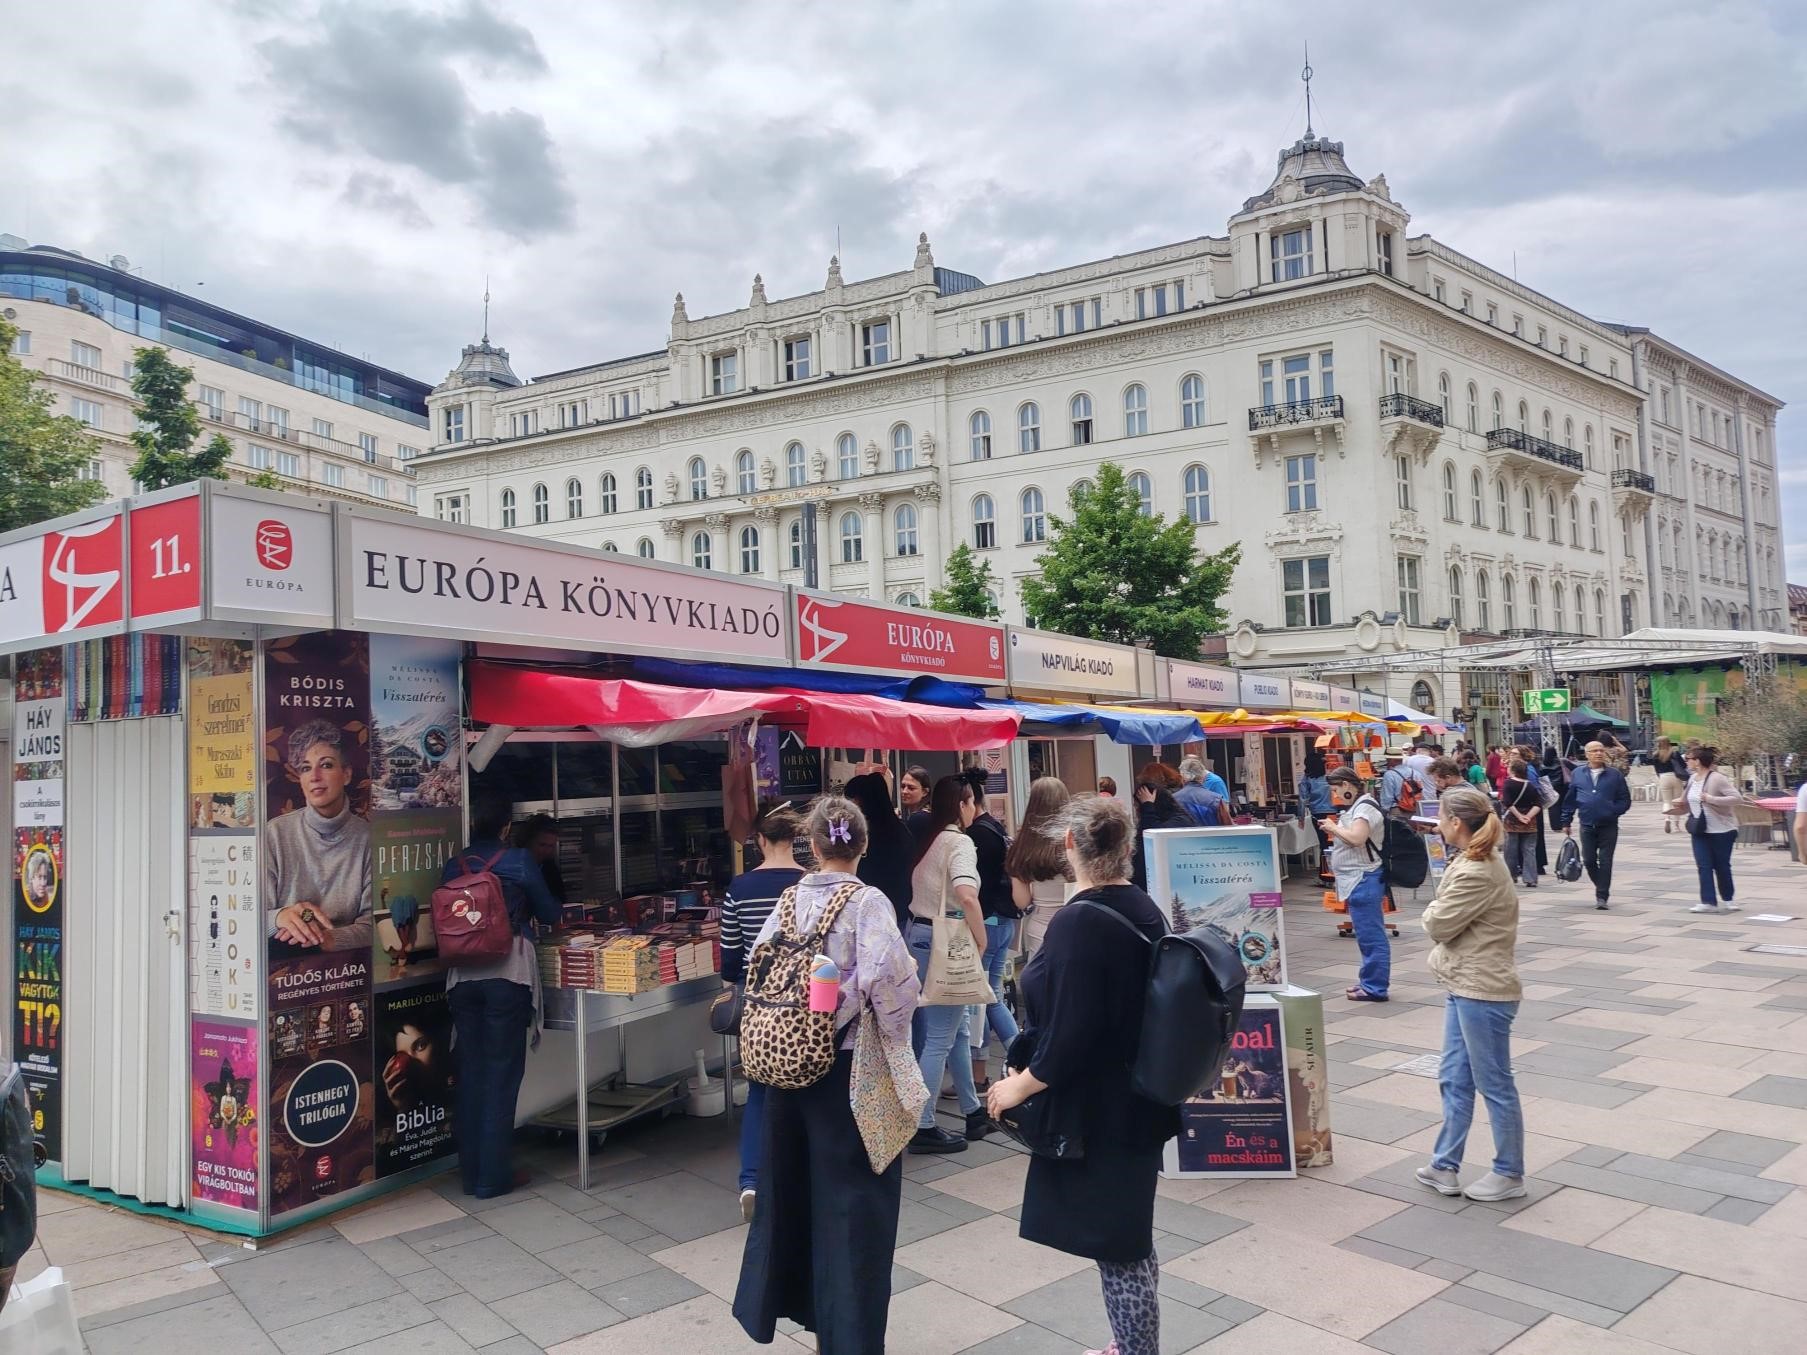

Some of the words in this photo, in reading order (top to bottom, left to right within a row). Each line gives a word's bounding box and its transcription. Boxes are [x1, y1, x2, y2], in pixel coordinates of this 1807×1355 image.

[150, 534, 191, 579] 11.
[246, 578, 304, 592] EURÓPA
[363, 550, 548, 609] EURÓPA
[560, 577, 780, 638] KÖNYVKIADÓ
[887, 623, 955, 653] EURÓPA
[901, 652, 945, 667] KÖNYVKIADÓ
[1042, 652, 1086, 673] NAPVILÁG
[1088, 658, 1113, 676] KIADÓ
[290, 673, 345, 691] BÓDIS
[1188, 676, 1208, 690] HARMAT
[1209, 678, 1224, 691] KIADÓ
[280, 694, 355, 709] KRISZTA
[383, 689, 447, 703] Visszatérés
[26, 705, 52, 730] HÁY
[19, 734, 61, 756] JÁNOS
[1193, 874, 1253, 885] Visszatérés
[19, 942, 60, 981] KIK
[275, 968, 322, 988] TÜDŐS
[325, 963, 366, 980] KLÁRA
[19, 982, 60, 1000] VAGYTOK
[277, 986, 320, 1001] REGÉNYES
[18, 1001, 60, 1050] TI?
[295, 1084, 350, 1110] ISTENHEGY
[299, 1103, 346, 1126] TRILÓGIA
[396, 1105, 445, 1134] Biblia
[1225, 1131, 1245, 1147] Én
[1250, 1132, 1265, 1145] és
[1270, 1138, 1278, 1148] a
[1208, 1150, 1284, 1165] macskáim
[197, 1160, 213, 1173] EGY
[214, 1165, 226, 1176] KIS
[228, 1166, 255, 1182] TOKIÓI
[197, 1174, 255, 1196] VIRÁGBOLTBAN
